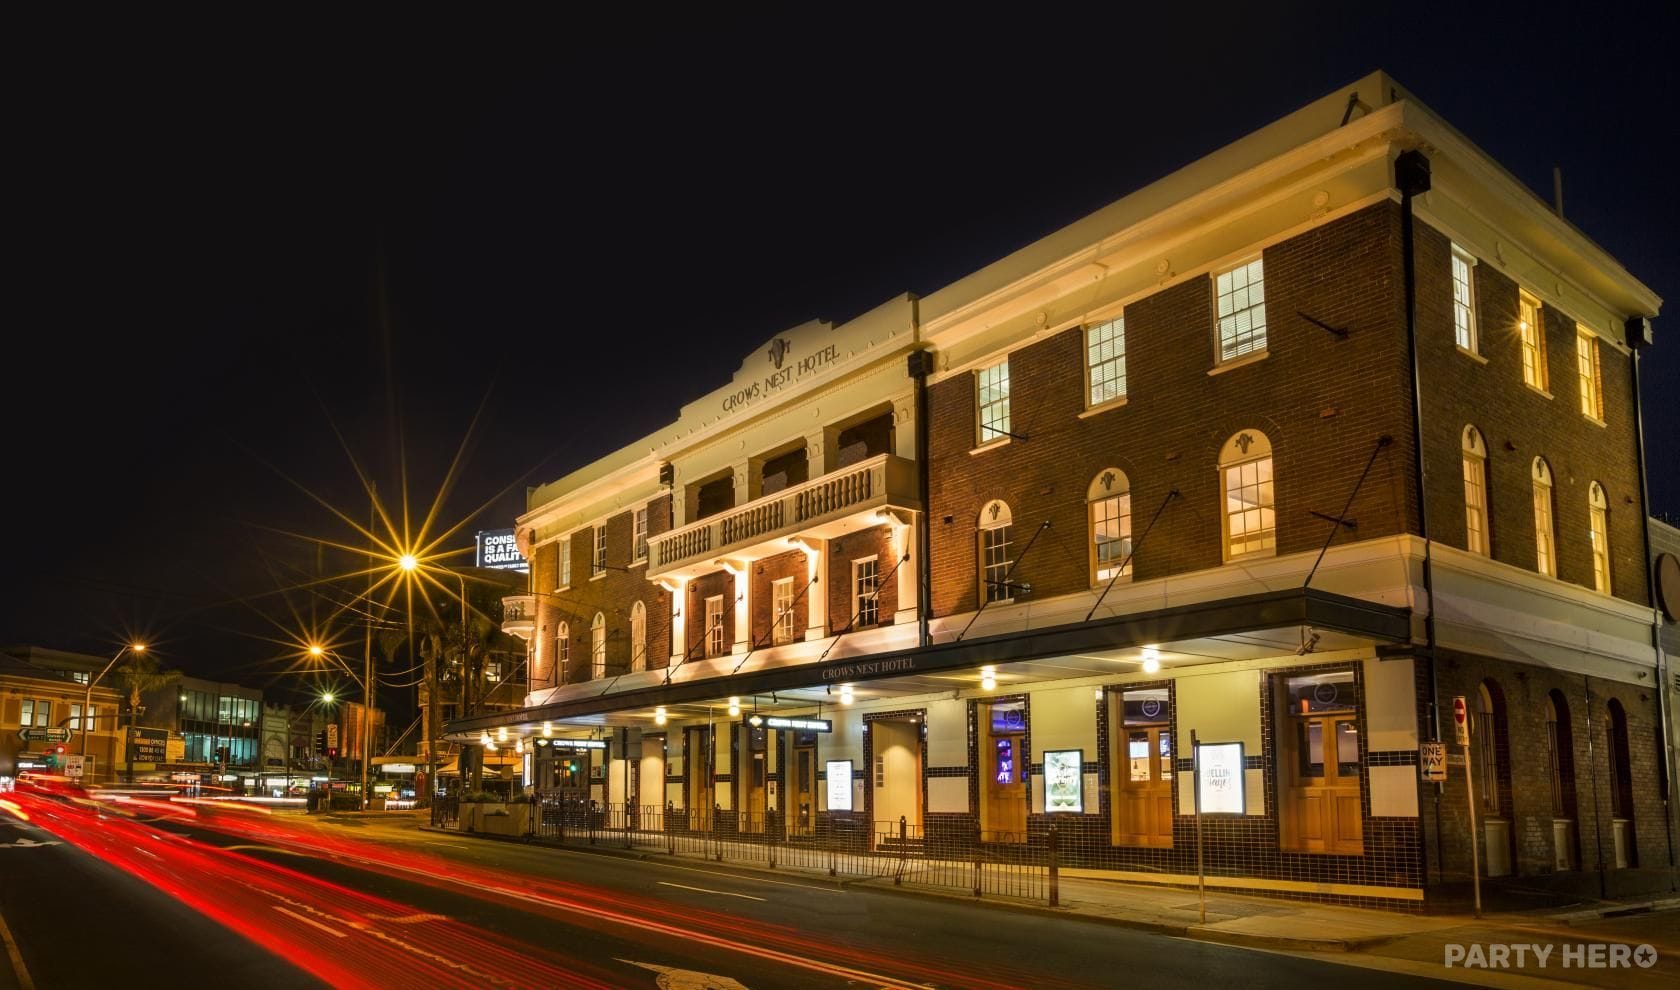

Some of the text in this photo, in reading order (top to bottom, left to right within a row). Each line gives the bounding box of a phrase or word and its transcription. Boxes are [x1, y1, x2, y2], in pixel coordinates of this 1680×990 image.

[765, 365, 793, 392] NEST
[797, 343, 840, 376] HOTEL
[484, 545, 495, 554] IS
[497, 544, 504, 553] A
[856, 662, 880, 674] NEST
[882, 657, 915, 672] HOTEL
[1422, 747, 1442, 756] ONE
[1422, 757, 1443, 766] WAY
